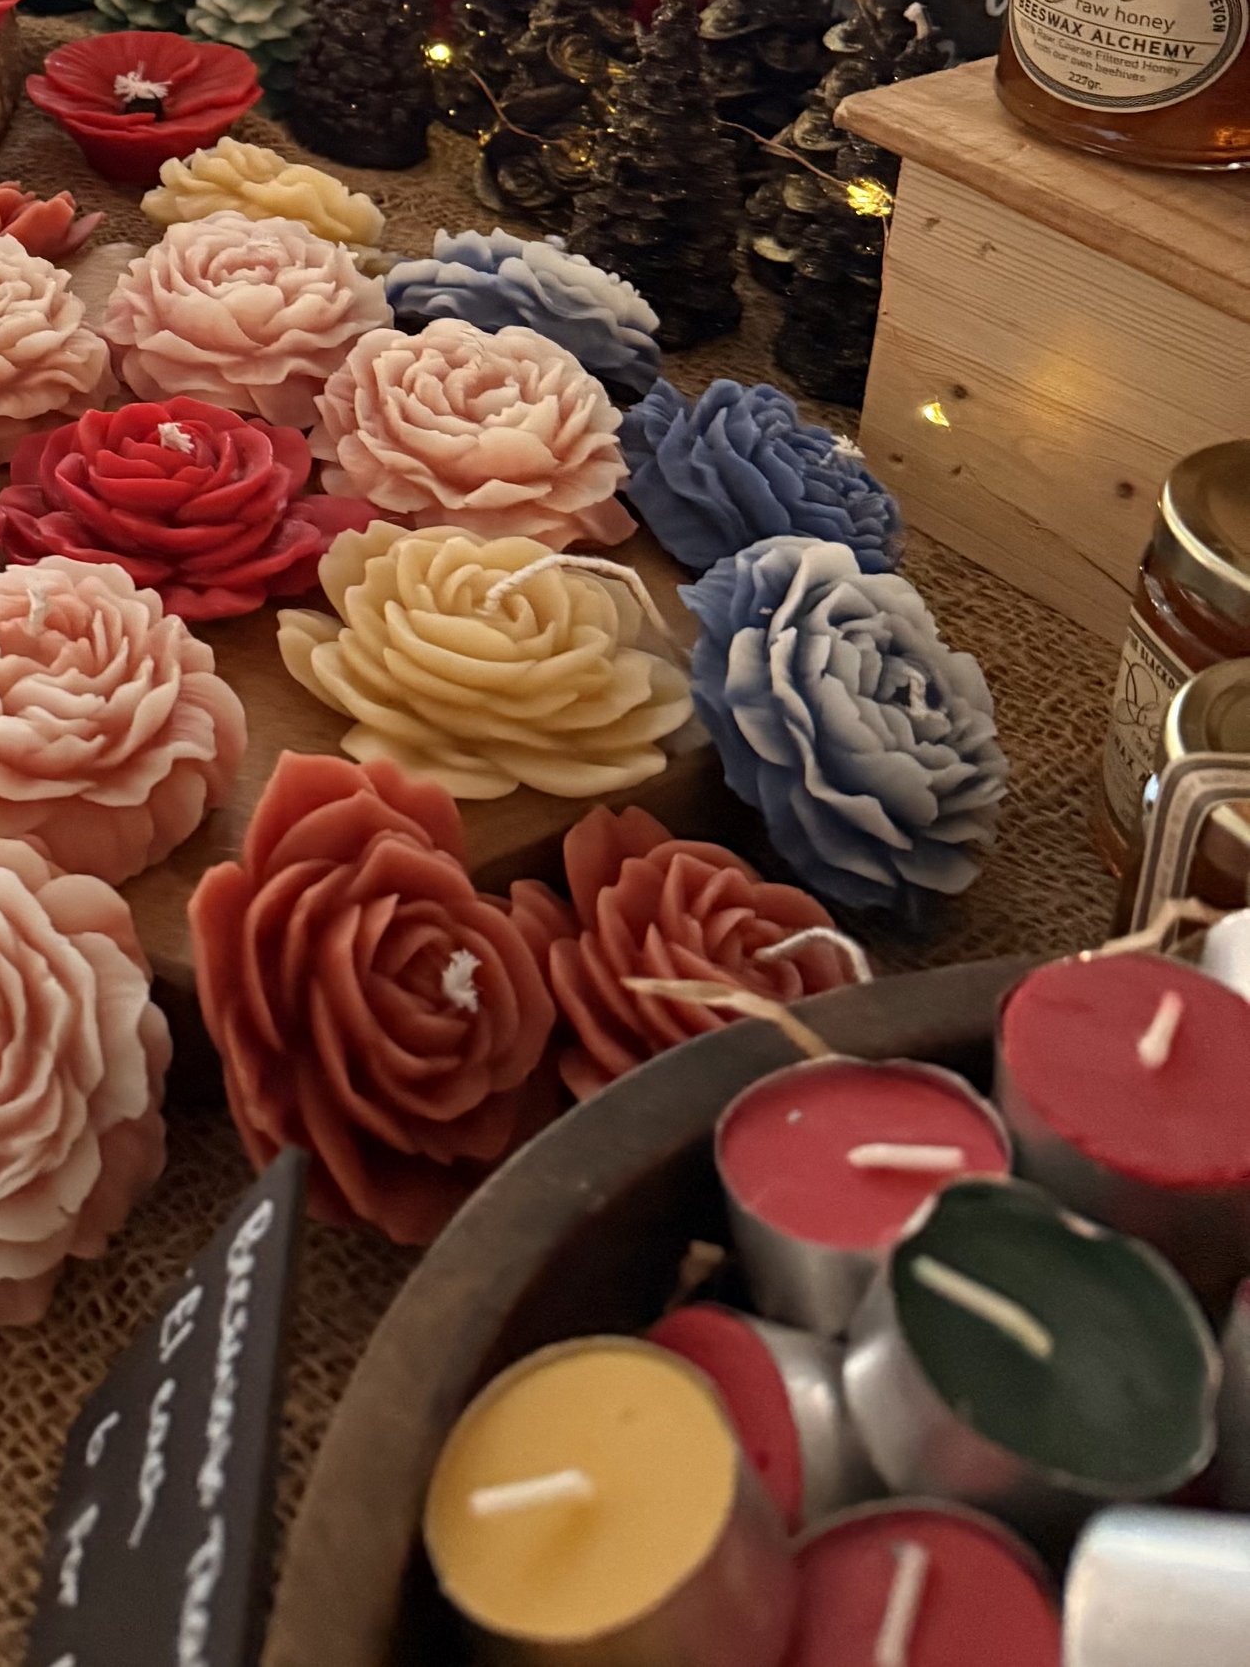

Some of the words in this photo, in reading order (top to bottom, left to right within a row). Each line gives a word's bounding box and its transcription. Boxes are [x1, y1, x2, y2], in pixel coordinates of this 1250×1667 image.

[1114, 5, 1177, 35] honey
[1090, 29, 1197, 60] ALCHEMY
[1095, 49, 1139, 70] Filtered
[1095, 63, 1147, 83] beehives
[1140, 646, 1176, 690] BLACKD
